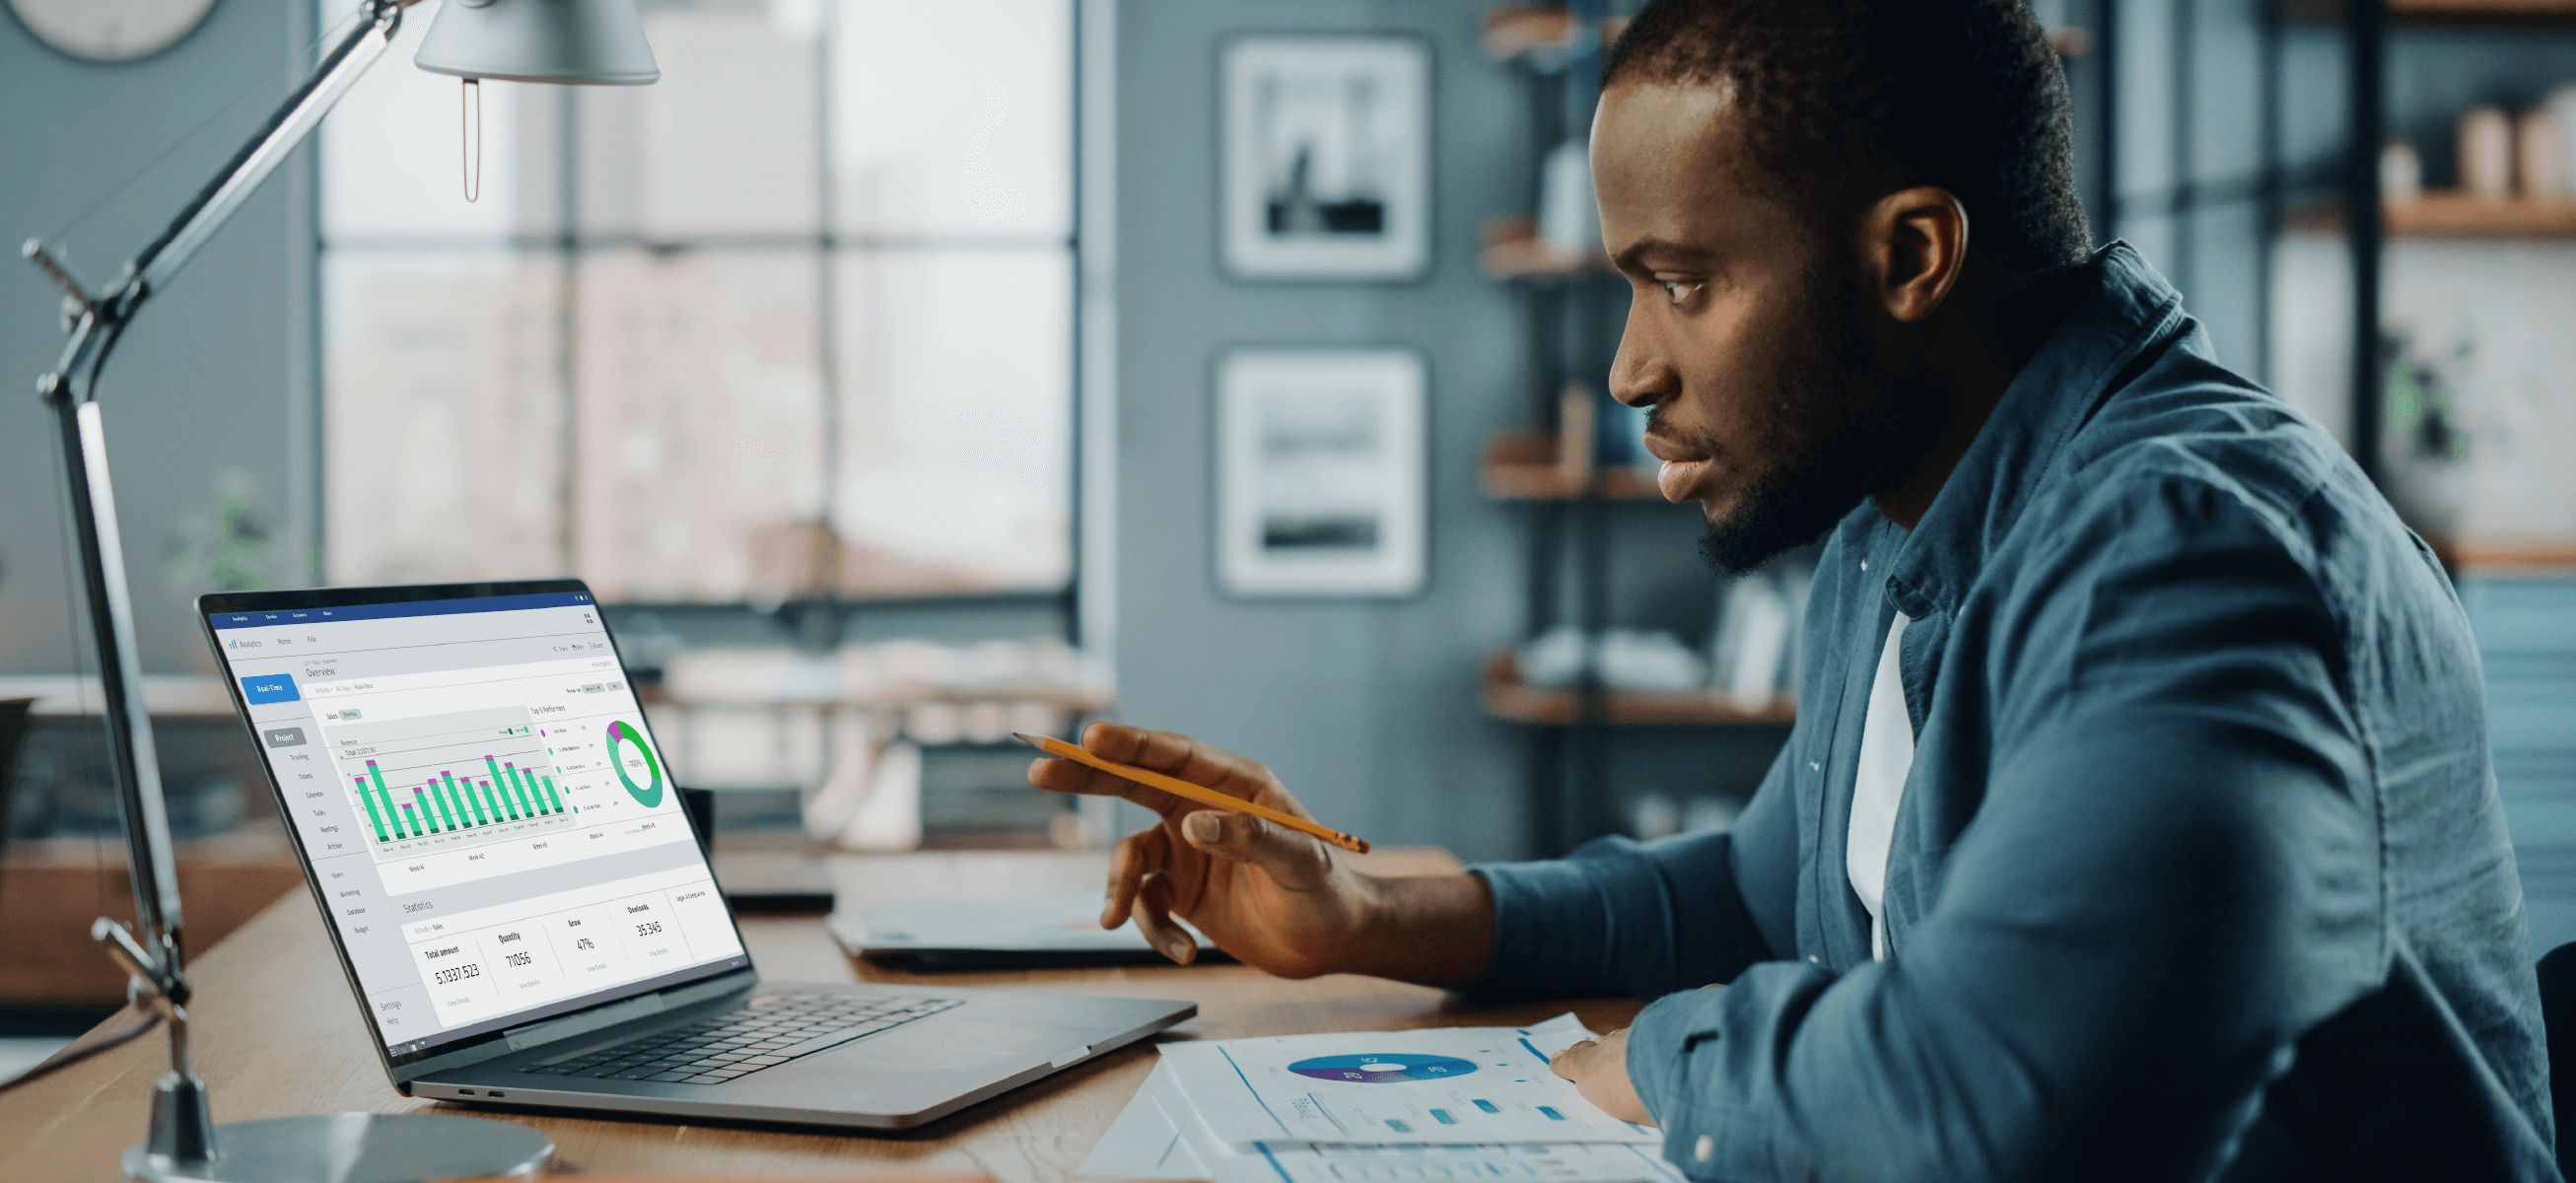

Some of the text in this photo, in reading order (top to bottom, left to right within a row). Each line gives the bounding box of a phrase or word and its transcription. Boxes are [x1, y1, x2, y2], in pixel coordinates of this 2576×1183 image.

[307, 667, 335, 677] Overview
[256, 684, 283, 693] Real-Time
[275, 733, 295, 742] Project
[339, 888, 361, 898] Marketing
[346, 906, 366, 916] Database
[403, 901, 433, 913] Statistics
[568, 919, 582, 928] Grow
[354, 926, 369, 935] Budget
[499, 931, 522, 945] Quantity
[577, 938, 594, 951] 47%
[425, 945, 459, 960] Total amount
[506, 951, 531, 968] 71056
[435, 963, 480, 986] 5,1337,523
[381, 1000, 402, 1011] Settings
[386, 1017, 399, 1026] Help
